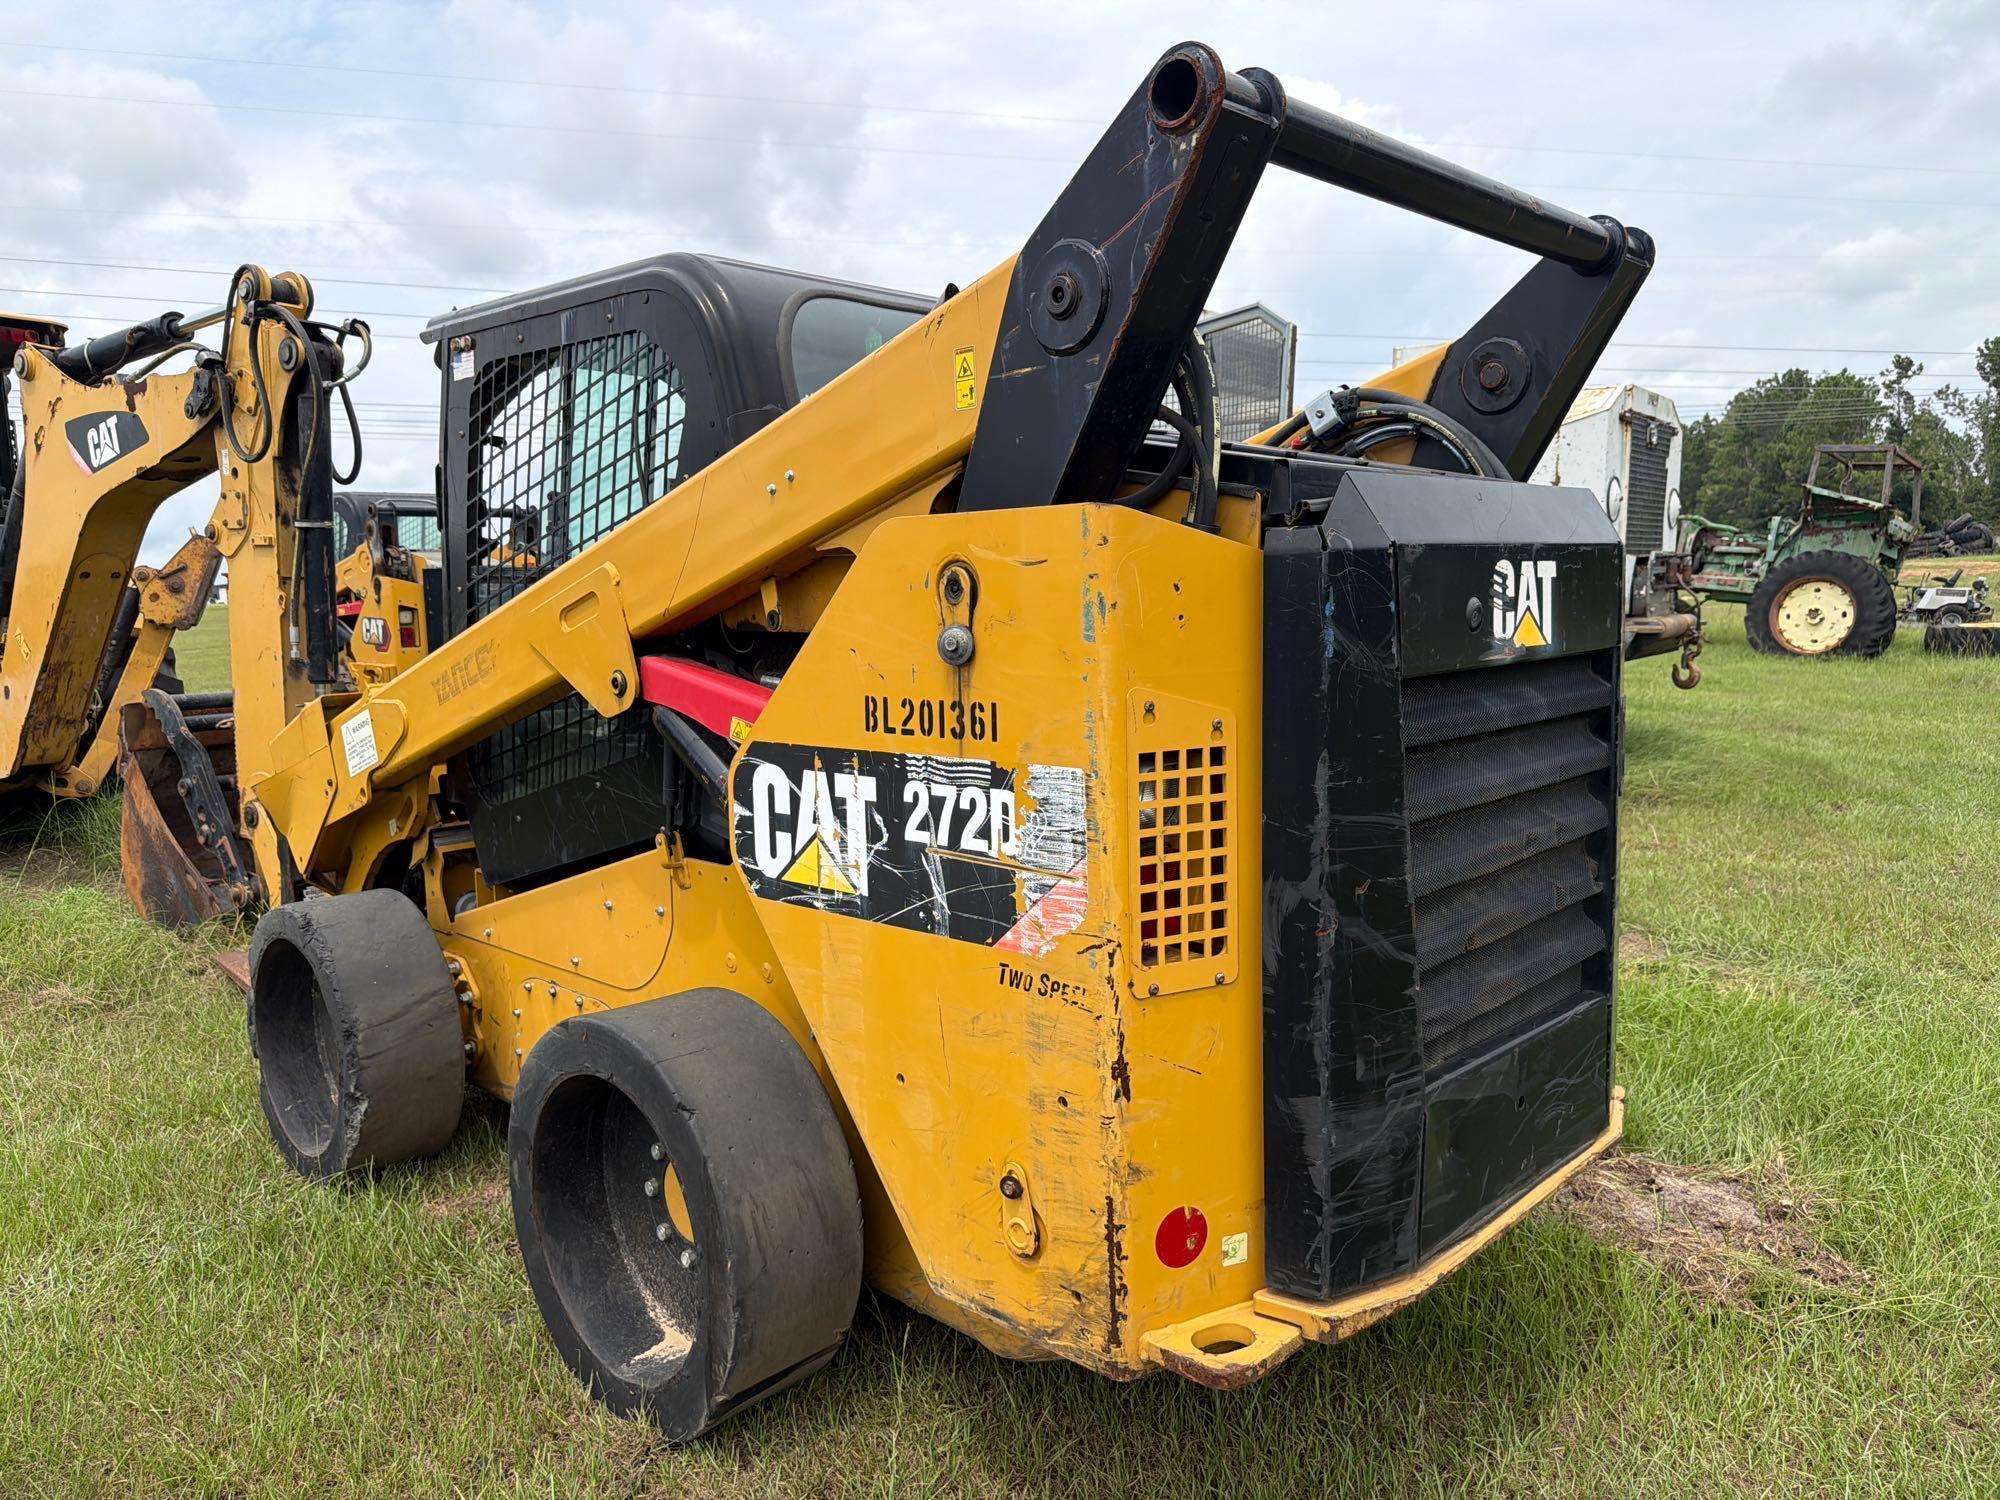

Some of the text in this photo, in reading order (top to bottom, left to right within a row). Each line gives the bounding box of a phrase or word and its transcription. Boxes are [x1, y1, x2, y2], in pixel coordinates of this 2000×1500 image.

[87, 414, 121, 468] CAT
[1493, 559, 1557, 645] CAT
[362, 618, 385, 644] CAT
[864, 695, 998, 742] BL201361
[752, 763, 878, 897] CAT
